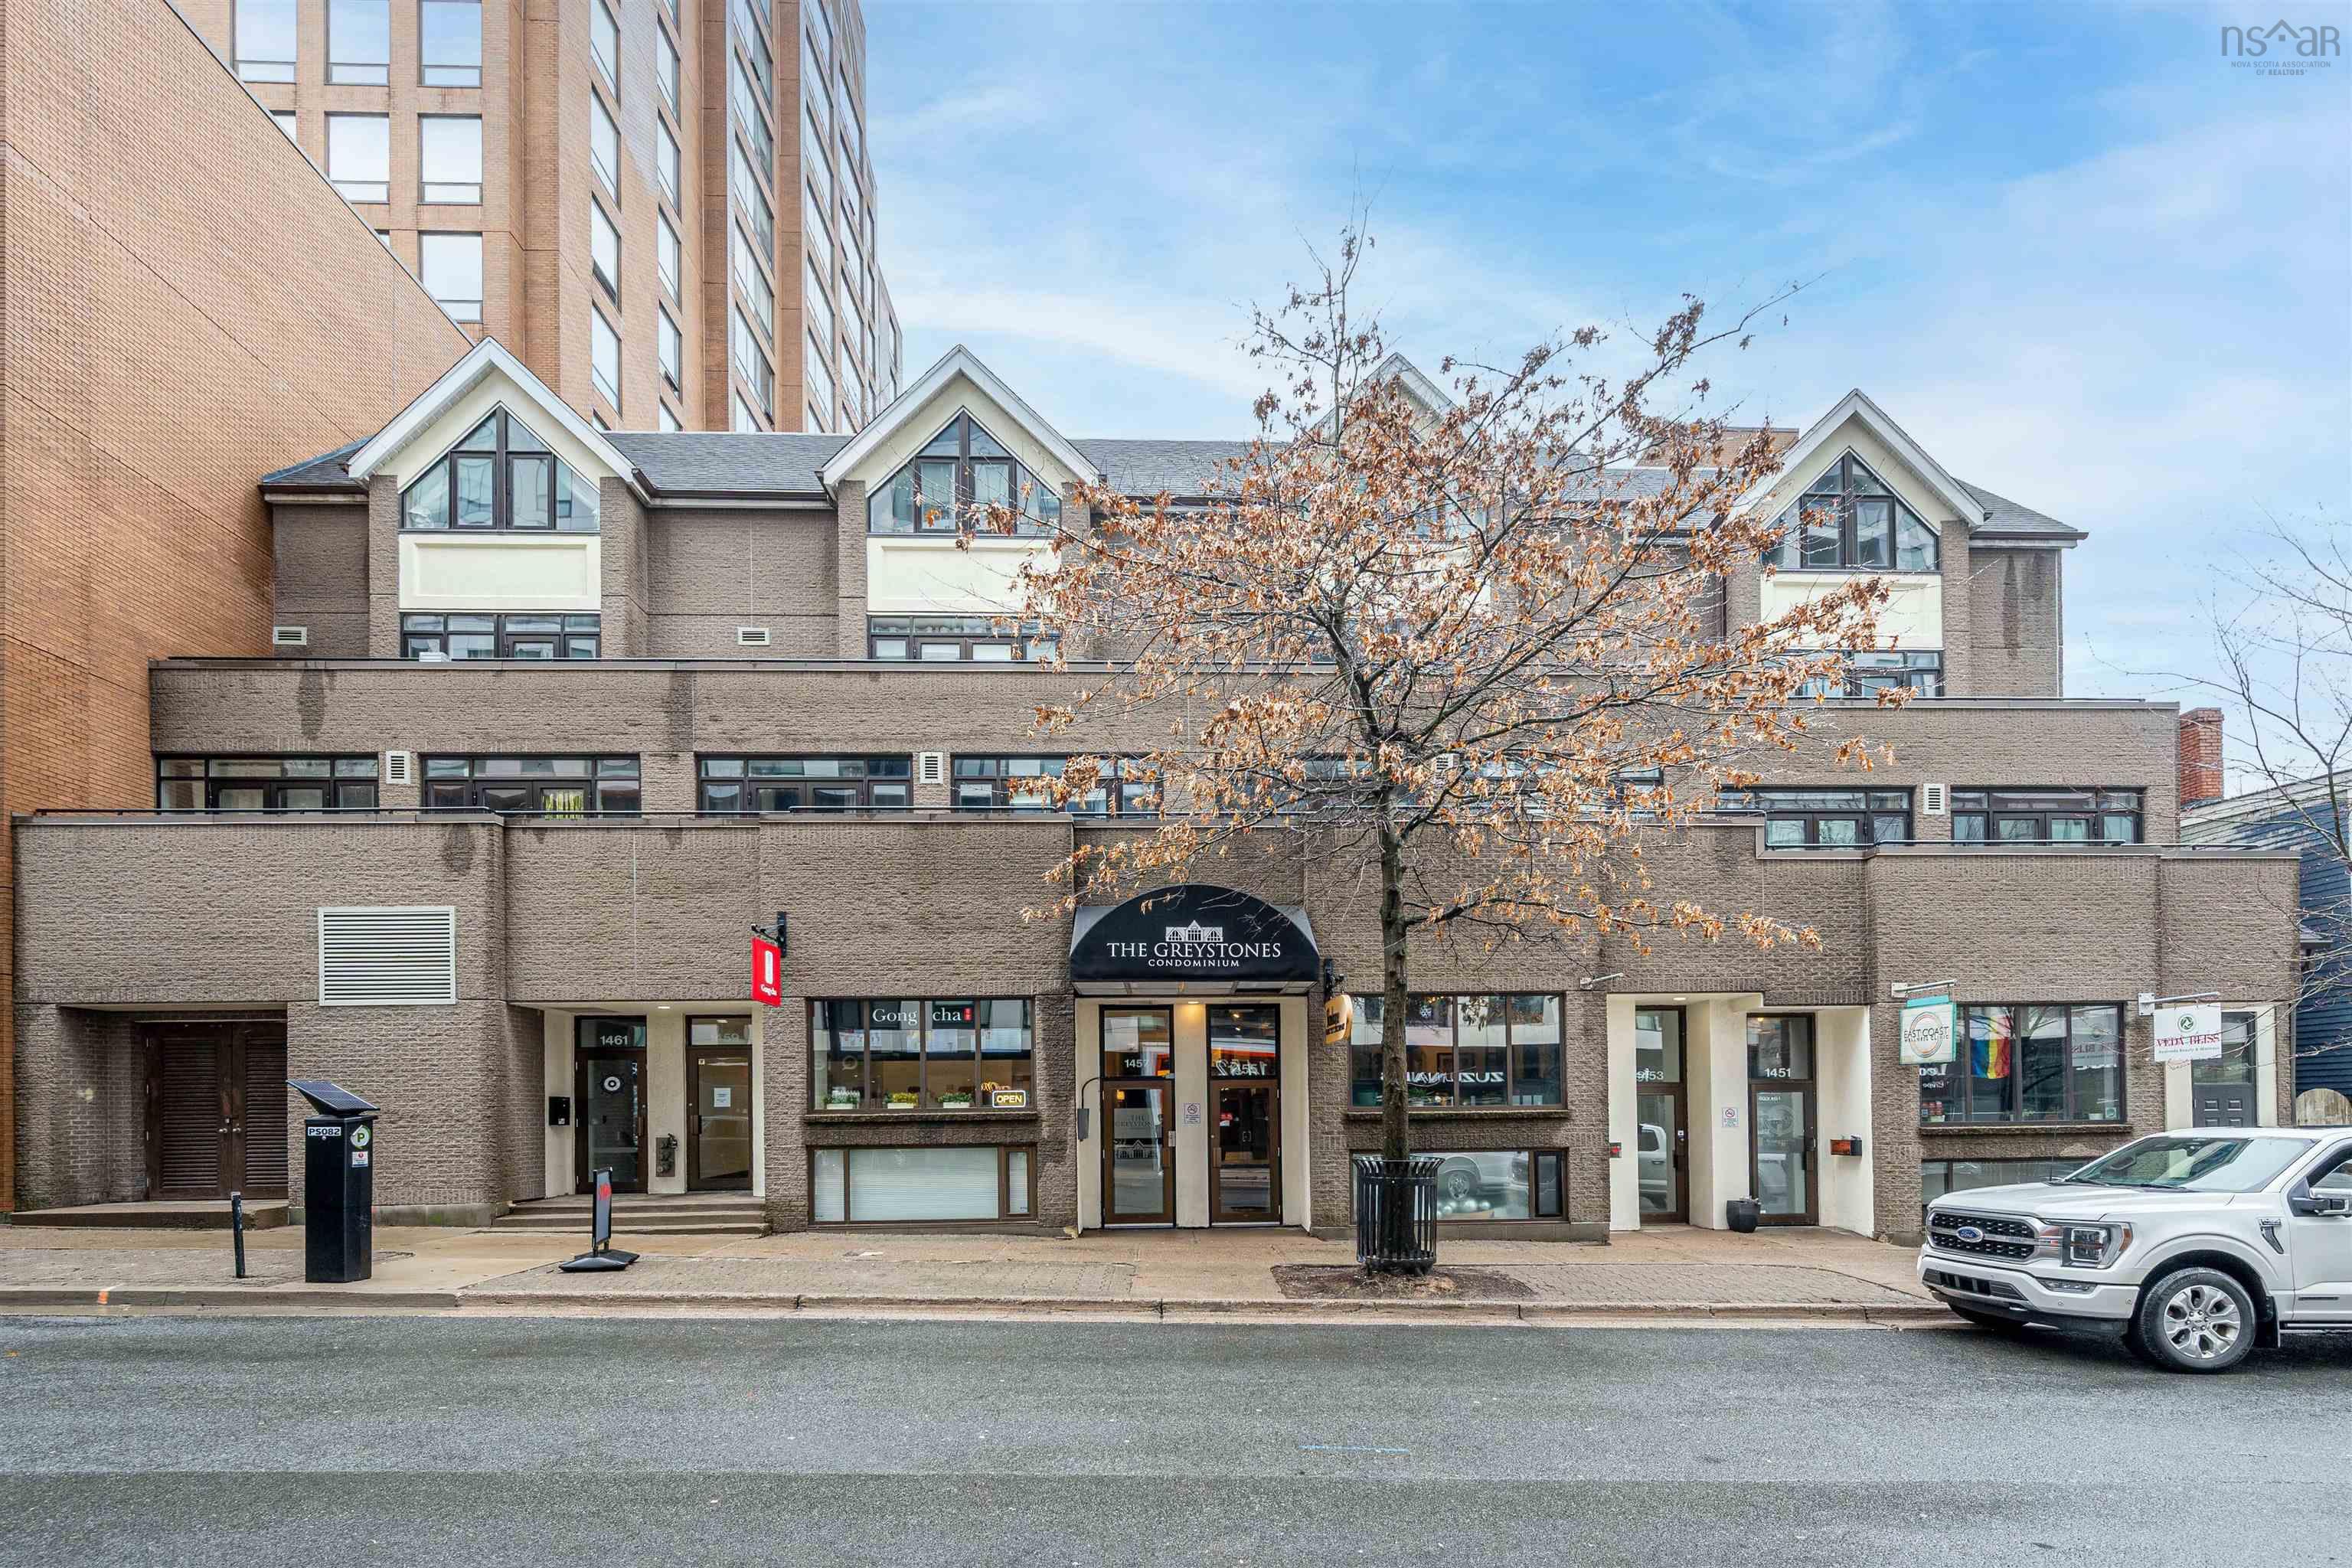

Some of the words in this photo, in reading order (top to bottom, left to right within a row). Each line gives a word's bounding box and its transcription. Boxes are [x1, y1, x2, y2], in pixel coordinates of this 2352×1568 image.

[1106, 942, 1147, 958] THE
[1154, 942, 1282, 958] GREYSTONES
[1148, 959, 1240, 967] CONDOMINIUM
[872, 1008, 918, 1027] Gong
[932, 1007, 962, 1022] cha
[1903, 1028, 1921, 1039] EAST
[1922, 1026, 1950, 1037] COAST
[599, 1035, 629, 1046] 1461
[2156, 1035, 2184, 1047] VEDA
[1124, 1059, 1151, 1069] 1457
[1764, 1067, 1792, 1078] 1451
[996, 1095, 1022, 1103] OPEN
[357, 1133, 365, 1142] P
